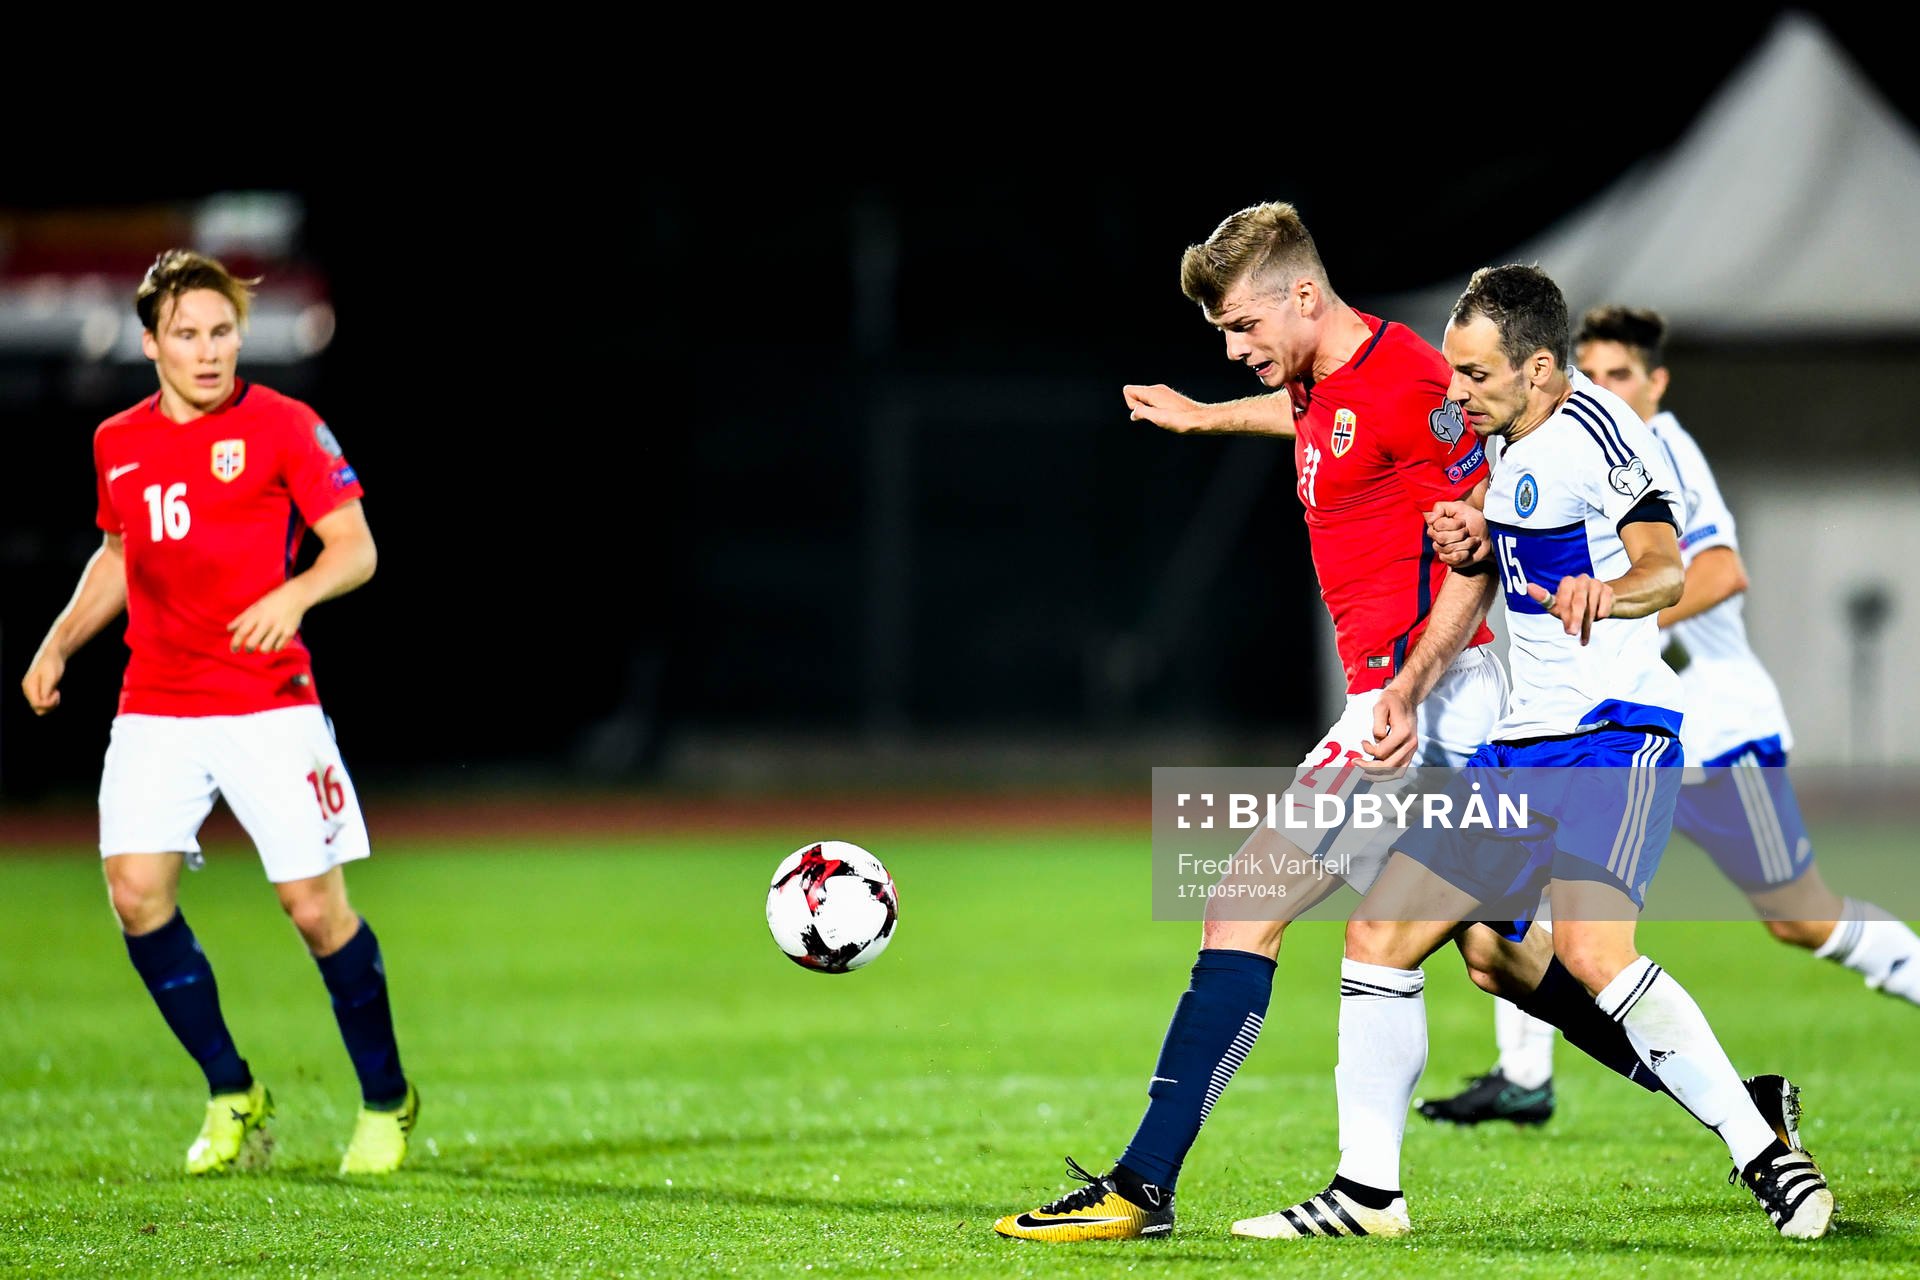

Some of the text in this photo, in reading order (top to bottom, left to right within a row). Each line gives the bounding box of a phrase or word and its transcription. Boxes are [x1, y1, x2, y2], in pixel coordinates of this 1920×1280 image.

[143, 482, 191, 542] 16
[1497, 533, 1528, 596] 15
[306, 764, 345, 821] 16
[1298, 741, 1363, 796] 21
